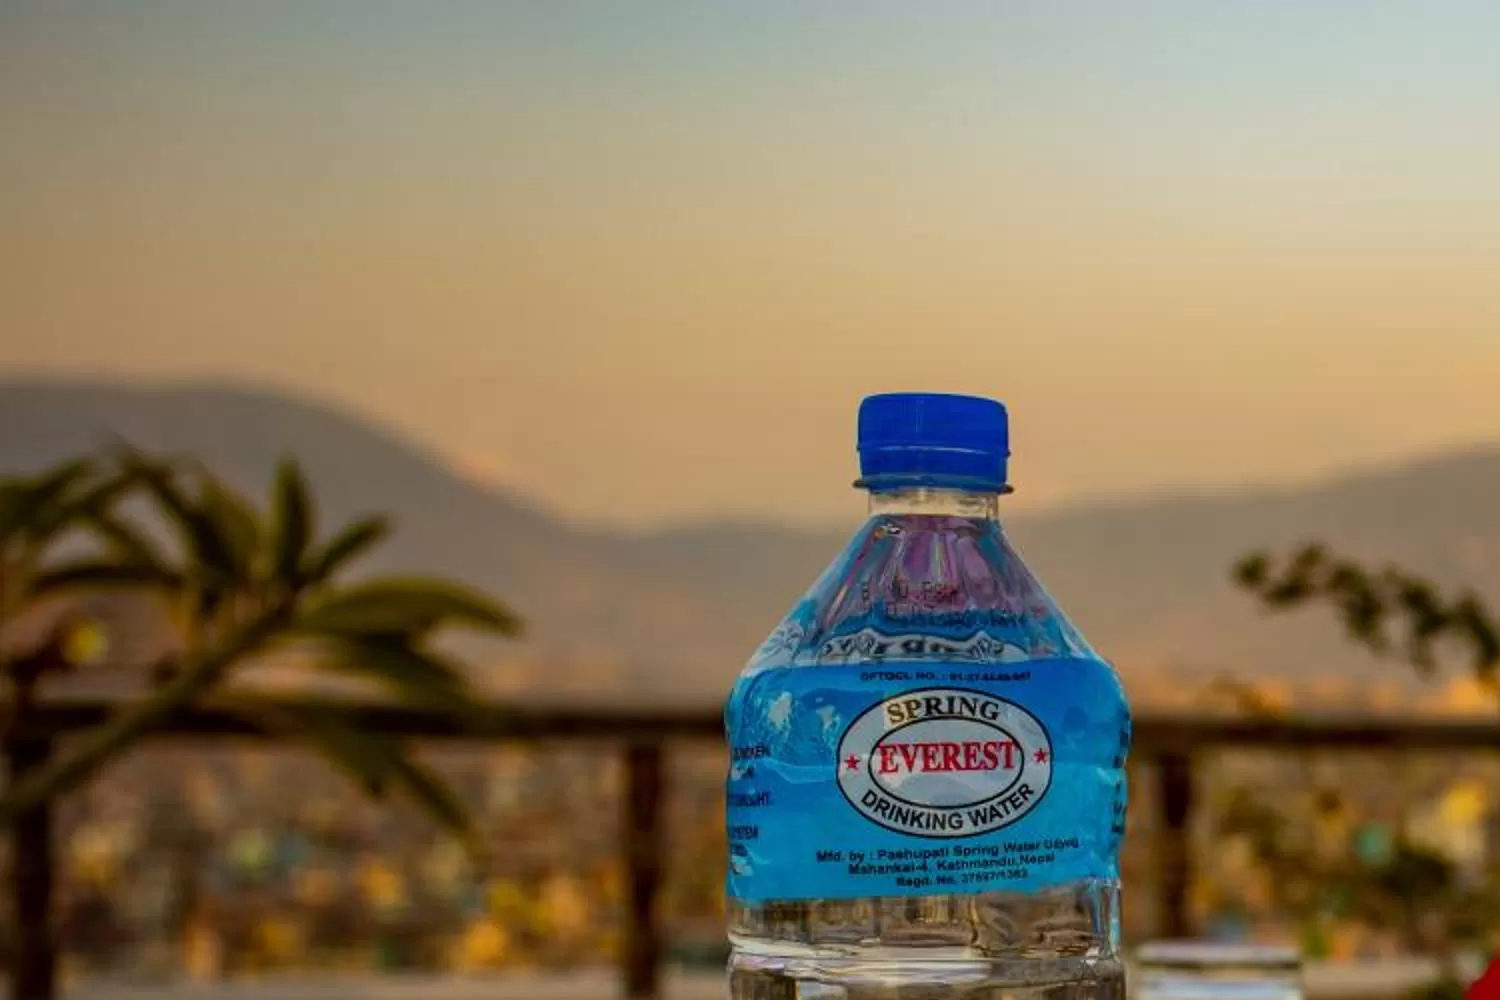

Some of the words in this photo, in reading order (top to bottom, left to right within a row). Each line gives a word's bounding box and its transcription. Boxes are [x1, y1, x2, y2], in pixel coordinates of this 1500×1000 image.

[886, 695, 999, 724] SPRING
[877, 740, 1015, 774] EVEREST
[861, 789, 964, 831] DRINKING
[967, 783, 1034, 827] WATER
[848, 850, 865, 864] by
[877, 846, 949, 861] Pashupati
[953, 844, 999, 858] Spring
[1003, 840, 1040, 853] Water
